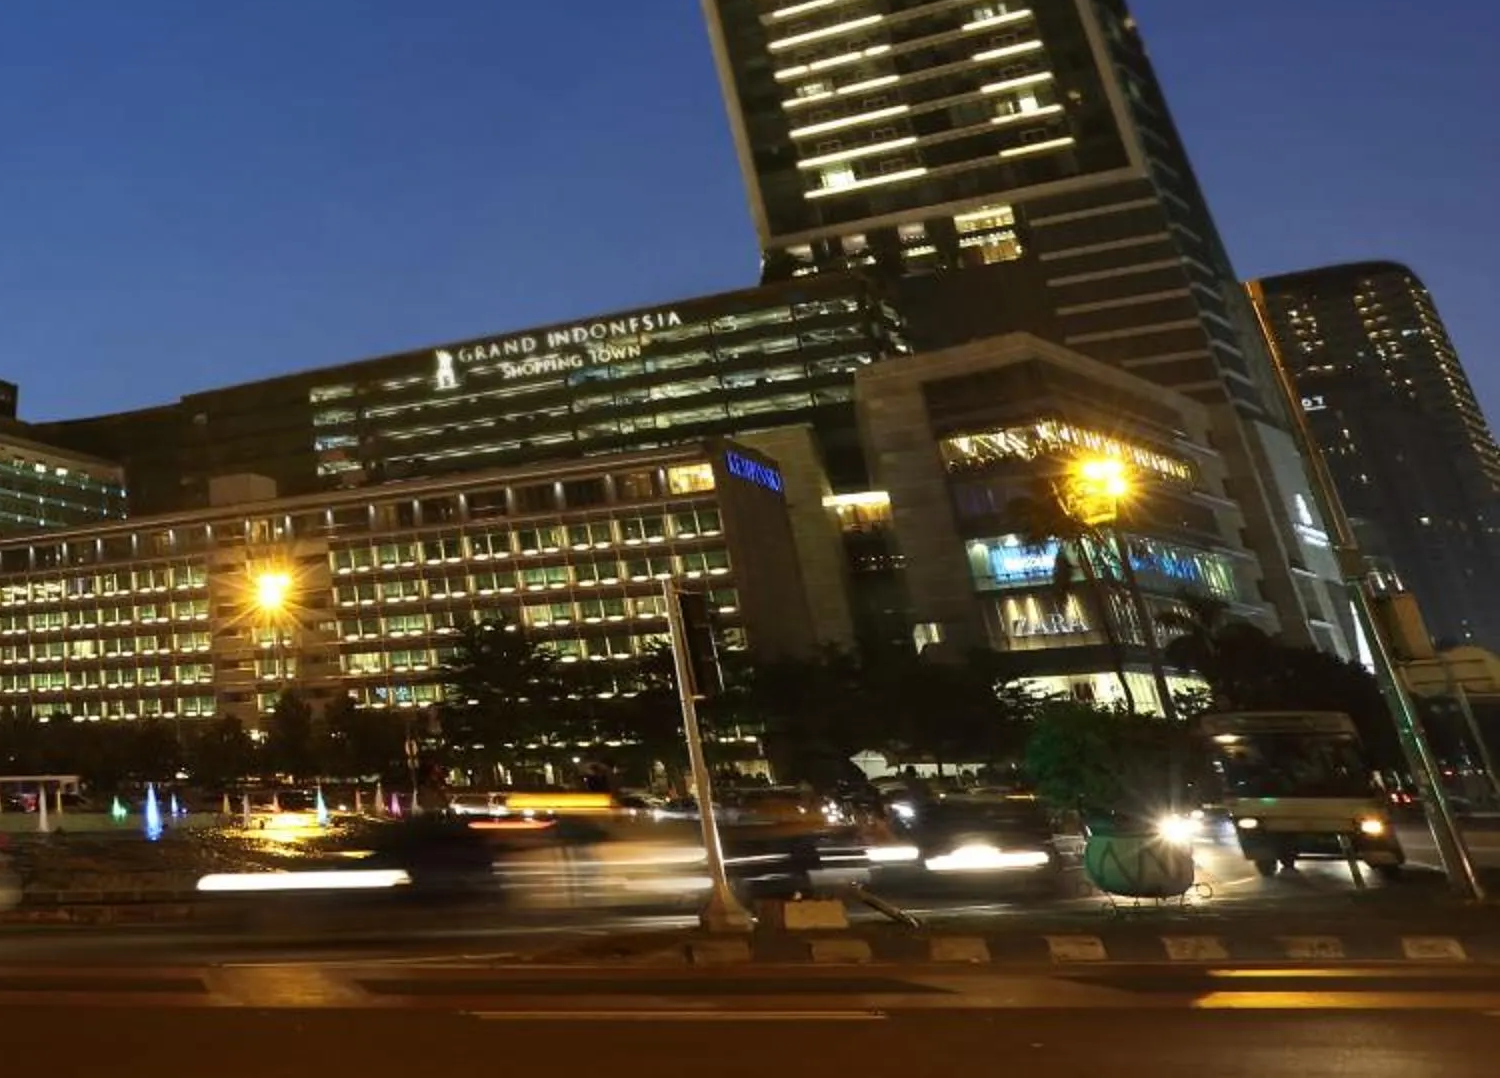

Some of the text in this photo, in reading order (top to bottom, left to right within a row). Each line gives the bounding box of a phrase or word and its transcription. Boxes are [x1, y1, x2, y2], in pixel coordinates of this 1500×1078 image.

[458, 337, 537, 363] GRAND
[501, 344, 642, 380] SHOPPING TOWN
